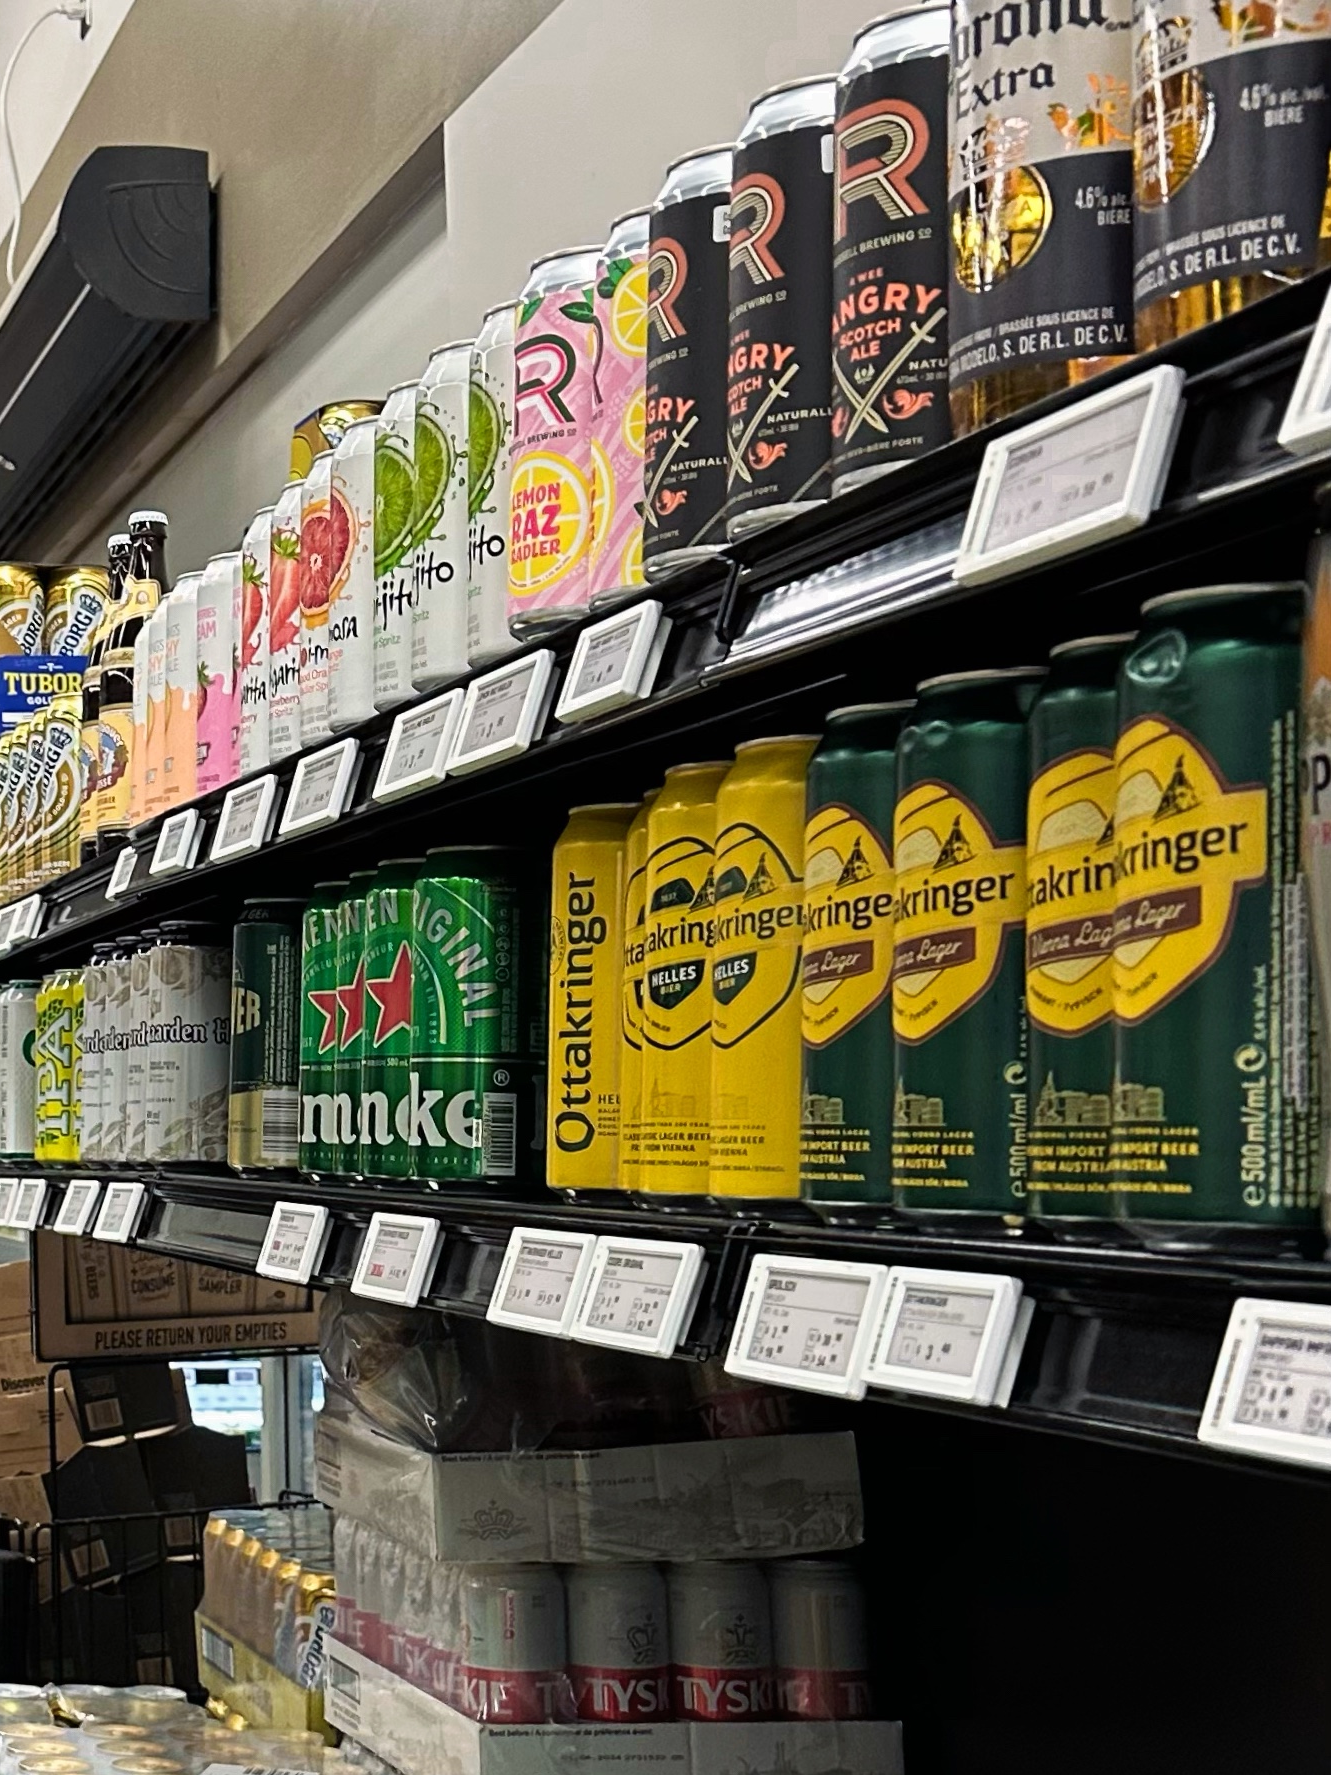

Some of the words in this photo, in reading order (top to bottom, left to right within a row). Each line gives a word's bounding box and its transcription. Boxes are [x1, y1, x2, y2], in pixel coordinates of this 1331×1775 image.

[955, 62, 1056, 118] Extra
[1075, 186, 1107, 209] 4.6%
[1227, 216, 1268, 237] LICENCE
[859, 229, 915, 253] BREWING
[1170, 259, 1182, 280] S.
[1184, 251, 1203, 275] DE
[1205, 245, 1237, 269] R.L.
[1240, 238, 1264, 261] DE
[1267, 233, 1302, 257] C.V.
[1036, 311, 1060, 327] SOUS
[1061, 307, 1099, 323] LICENCE
[1101, 306, 1115, 320] DE
[839, 317, 902, 350] SCOTCH
[1003, 339, 1015, 359] S.
[1019, 332, 1037, 355] DE
[1039, 330, 1070, 351] R.L.
[1074, 326, 1095, 346] DE
[1098, 323, 1128, 344] C.V.
[850, 340, 881, 362] ALE
[909, 358, 949, 370] NATU
[766, 406, 834, 423] NATURALL
[527, 430, 565, 444] BREWING
[670, 456, 729, 473] NATURALL
[512, 482, 561, 513] LEMON
[511, 504, 562, 546] RAZ
[1028, 860, 1116, 910] takrin
[804, 893, 893, 935] kringe
[1134, 900, 1186, 930] Lager
[1073, 921, 1114, 948] Lag
[917, 938, 963, 963] Lager
[820, 950, 862, 974] Lager
[651, 965, 697, 987] HELLES
[554, 872, 607, 1153] Ottakringer
[597, 1093, 621, 1105] HEL
[842, 1141, 871, 1152] BEER
[942, 1144, 975, 1157] BEER
[1055, 1145, 1105, 1158] IMPORT
[1162, 1142, 1199, 1157] BEER
[903, 1158, 947, 1171] AUSTRIA
[131, 1275, 175, 1295] CONSUME
[198, 1276, 242, 1294] SAMPLER
[95, 1329, 142, 1350] PLEASE
[146, 1327, 194, 1349] RETURN
[196, 1324, 231, 1345] YOUR
[235, 1322, 287, 1342] EMPTIES
[0, 1375, 46, 1391] Discover
